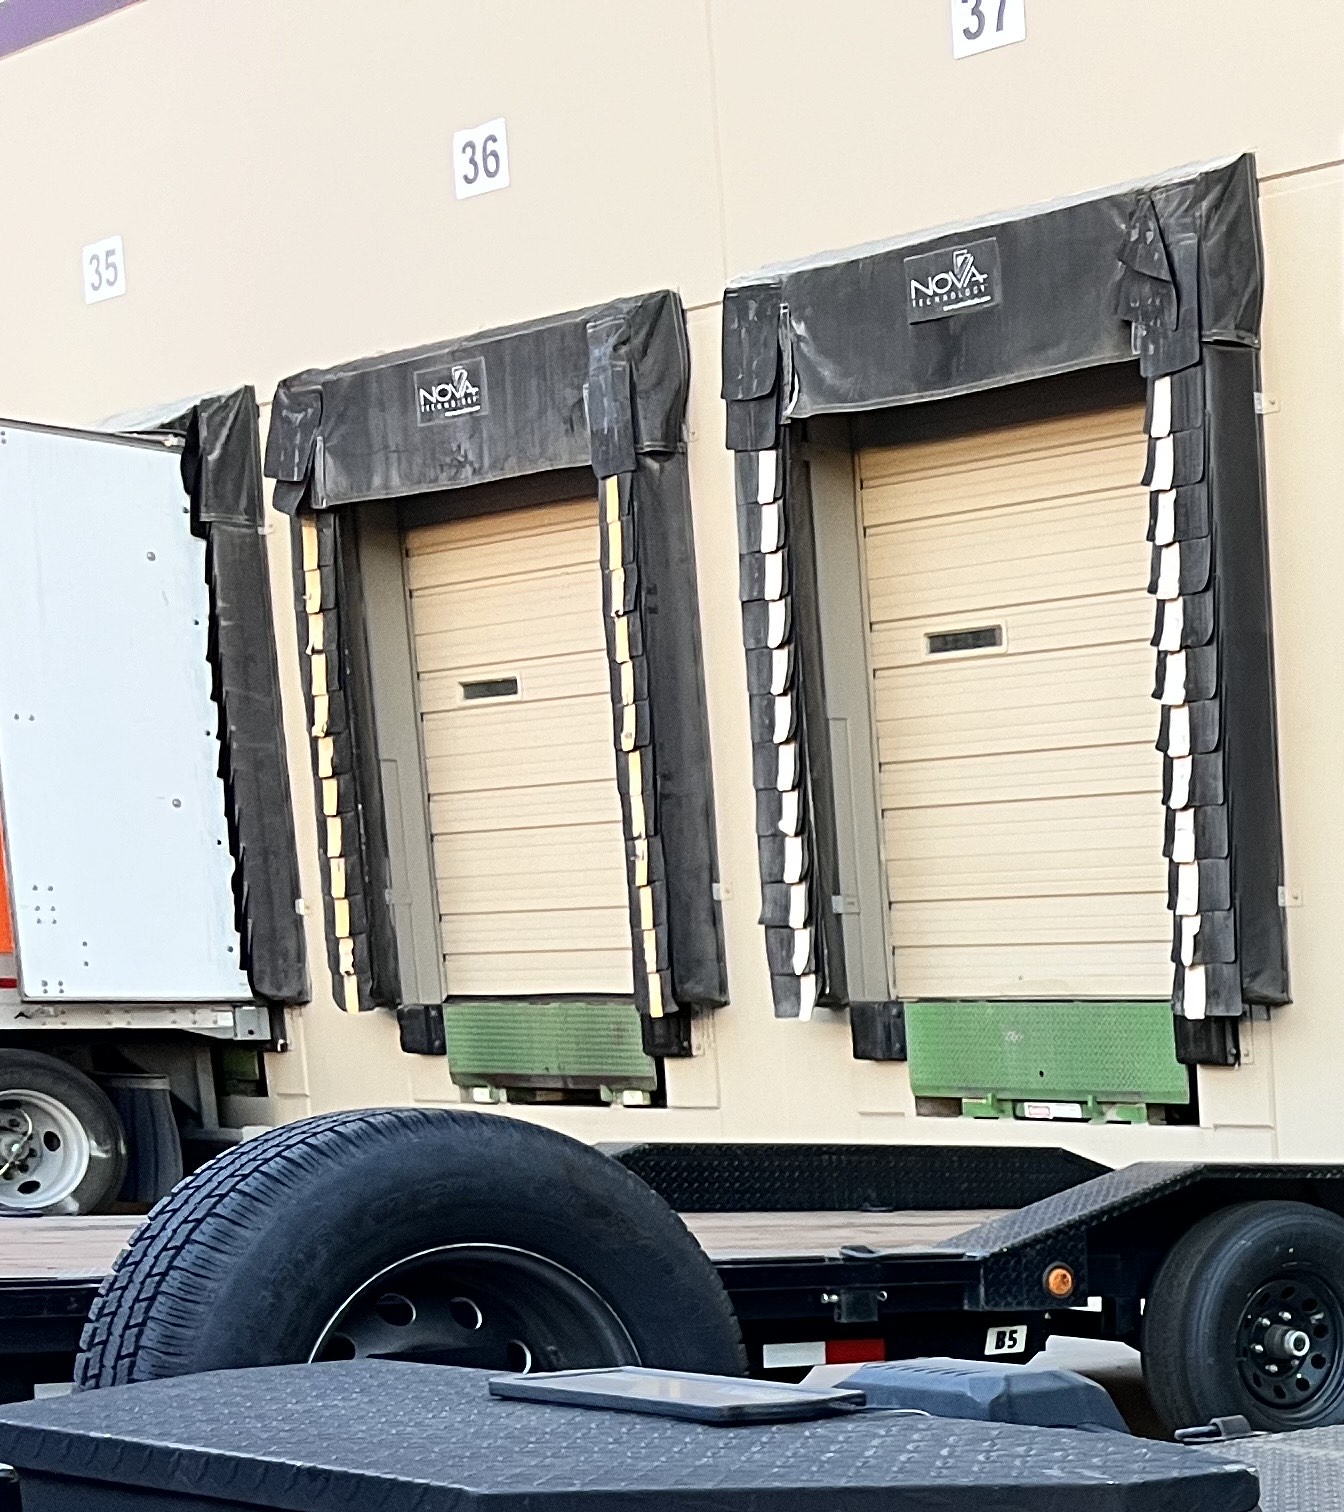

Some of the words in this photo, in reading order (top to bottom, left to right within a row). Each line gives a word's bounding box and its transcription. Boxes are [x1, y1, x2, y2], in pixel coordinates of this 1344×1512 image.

[461, 134, 500, 185] 36
[89, 248, 118, 292] 35
[910, 249, 988, 300] NOVA
[419, 365, 480, 406] NOVA
[994, 1329, 1018, 1350] B5
